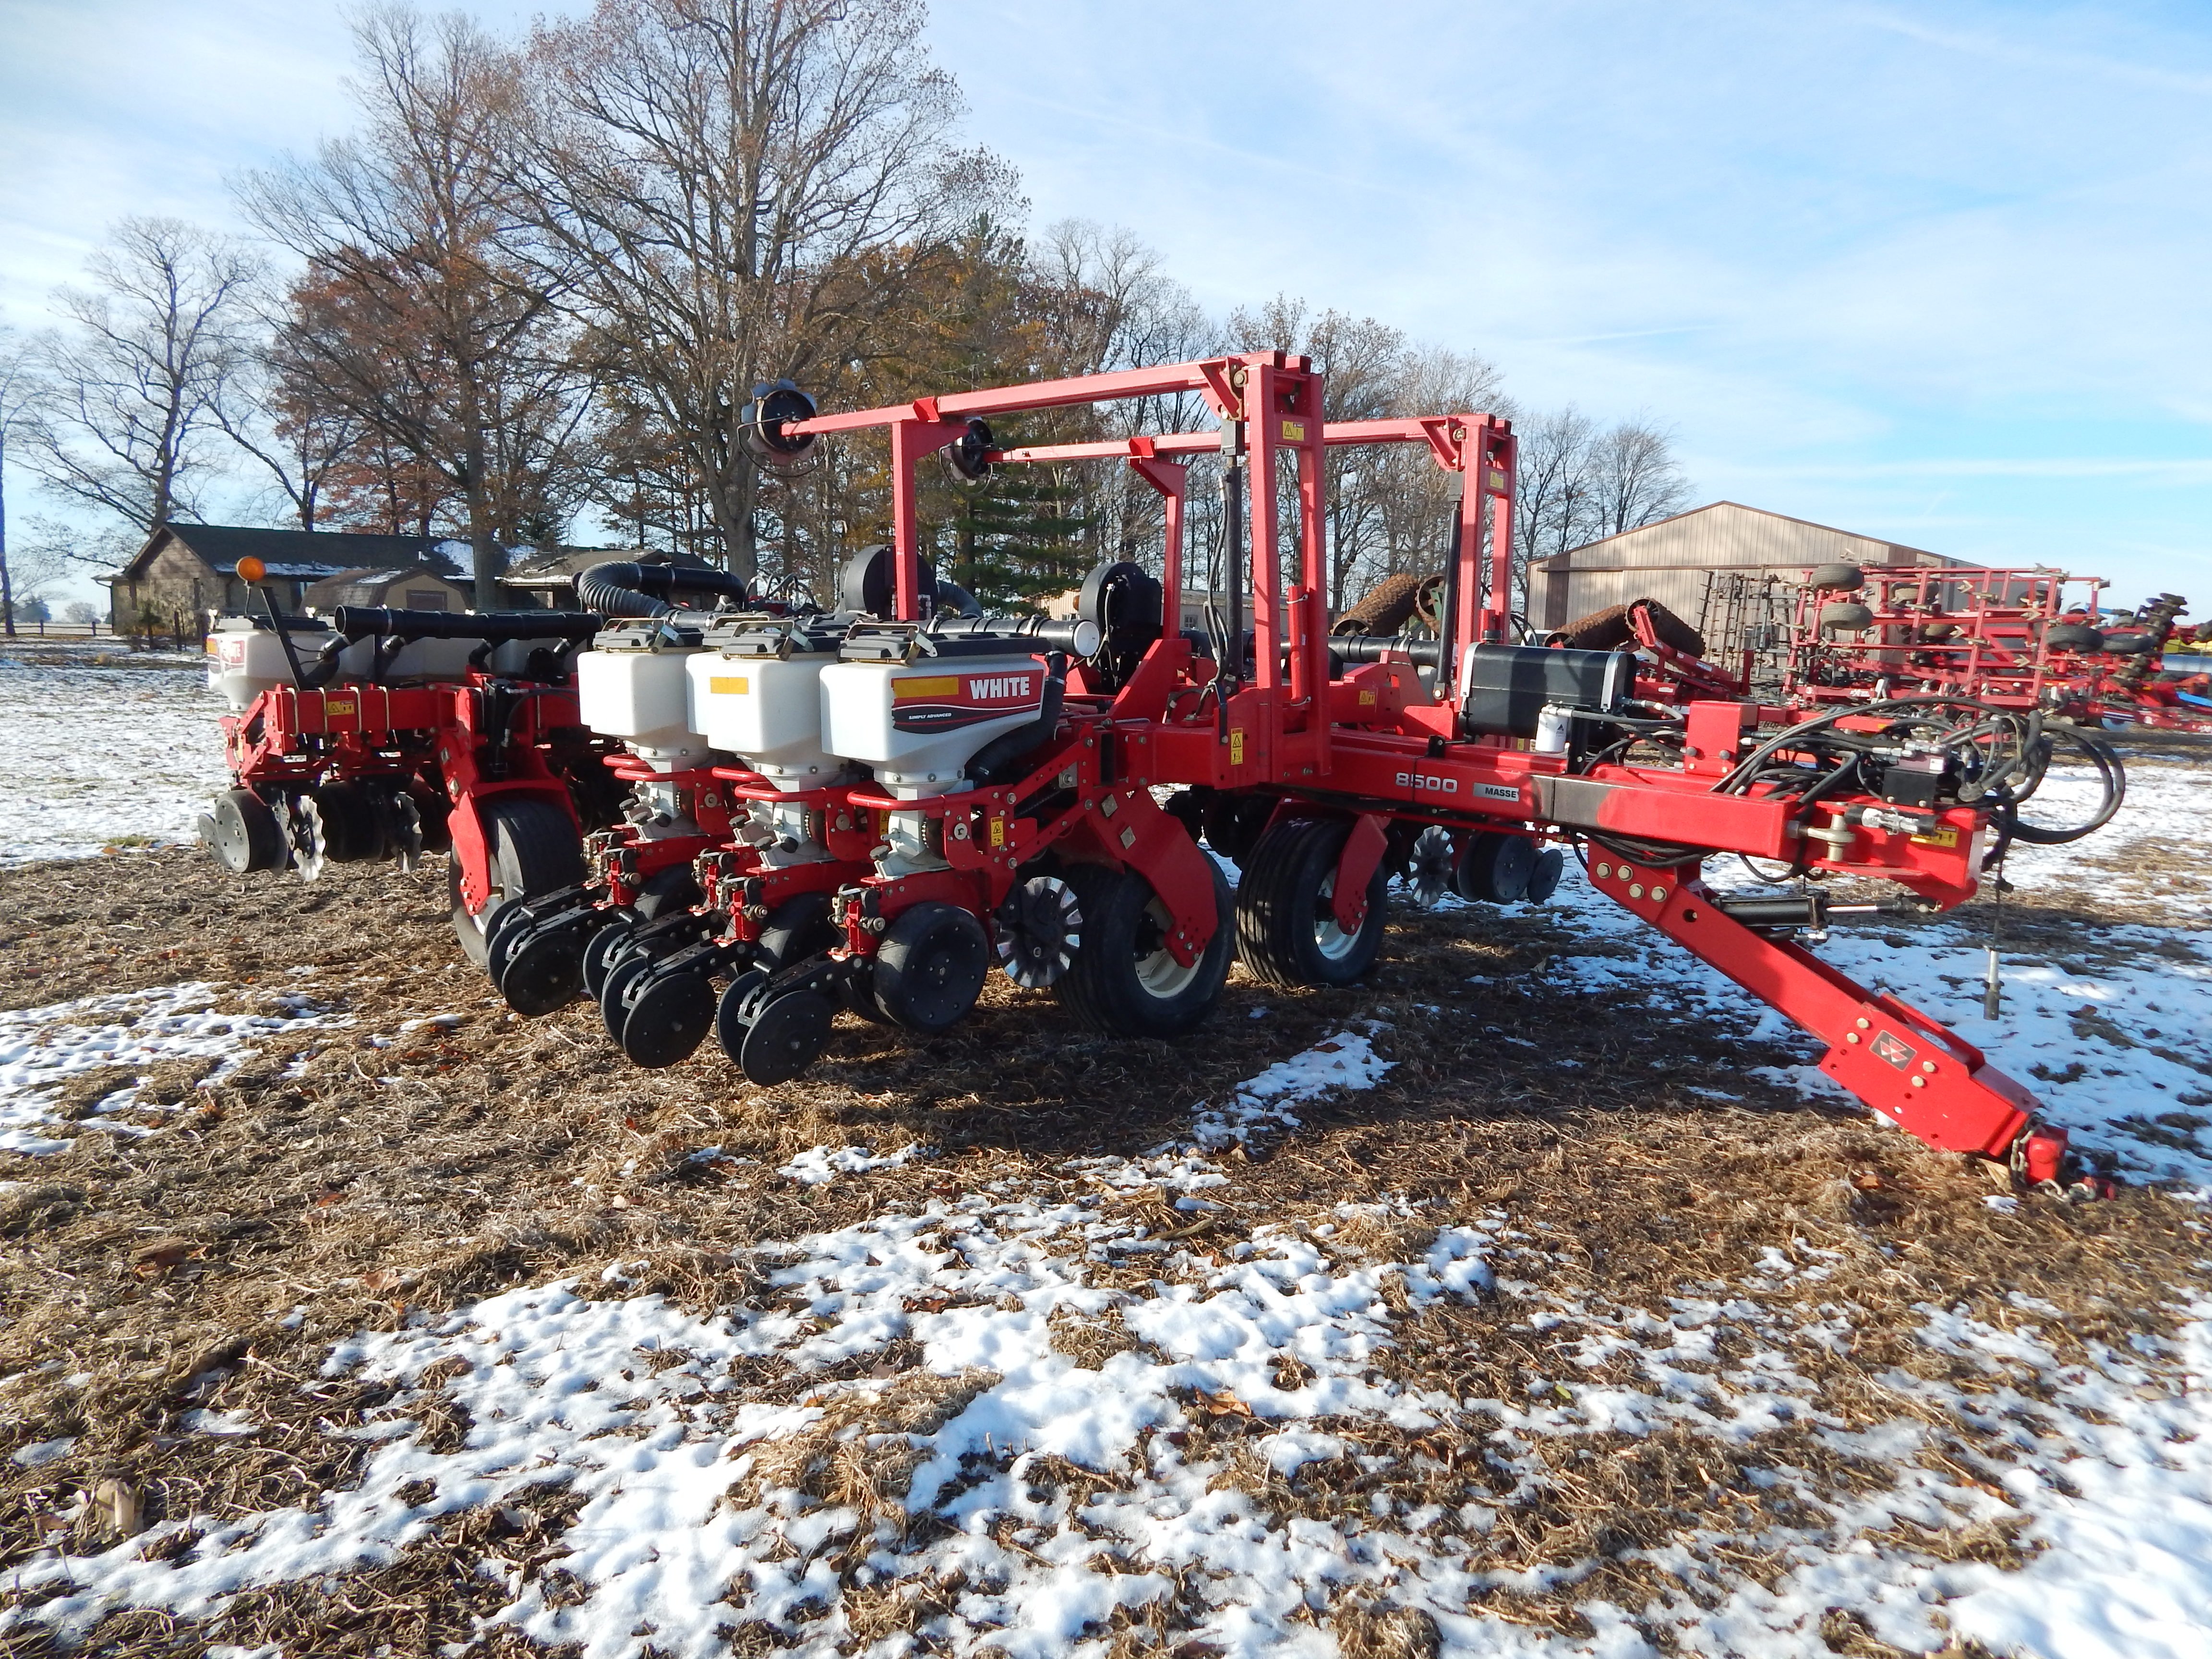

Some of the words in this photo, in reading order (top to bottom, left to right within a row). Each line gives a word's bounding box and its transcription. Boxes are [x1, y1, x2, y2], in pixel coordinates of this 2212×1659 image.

[969, 676, 1030, 699] WHITE
[1395, 772, 1457, 793] 8500
[1485, 787, 1519, 798] MASSE
